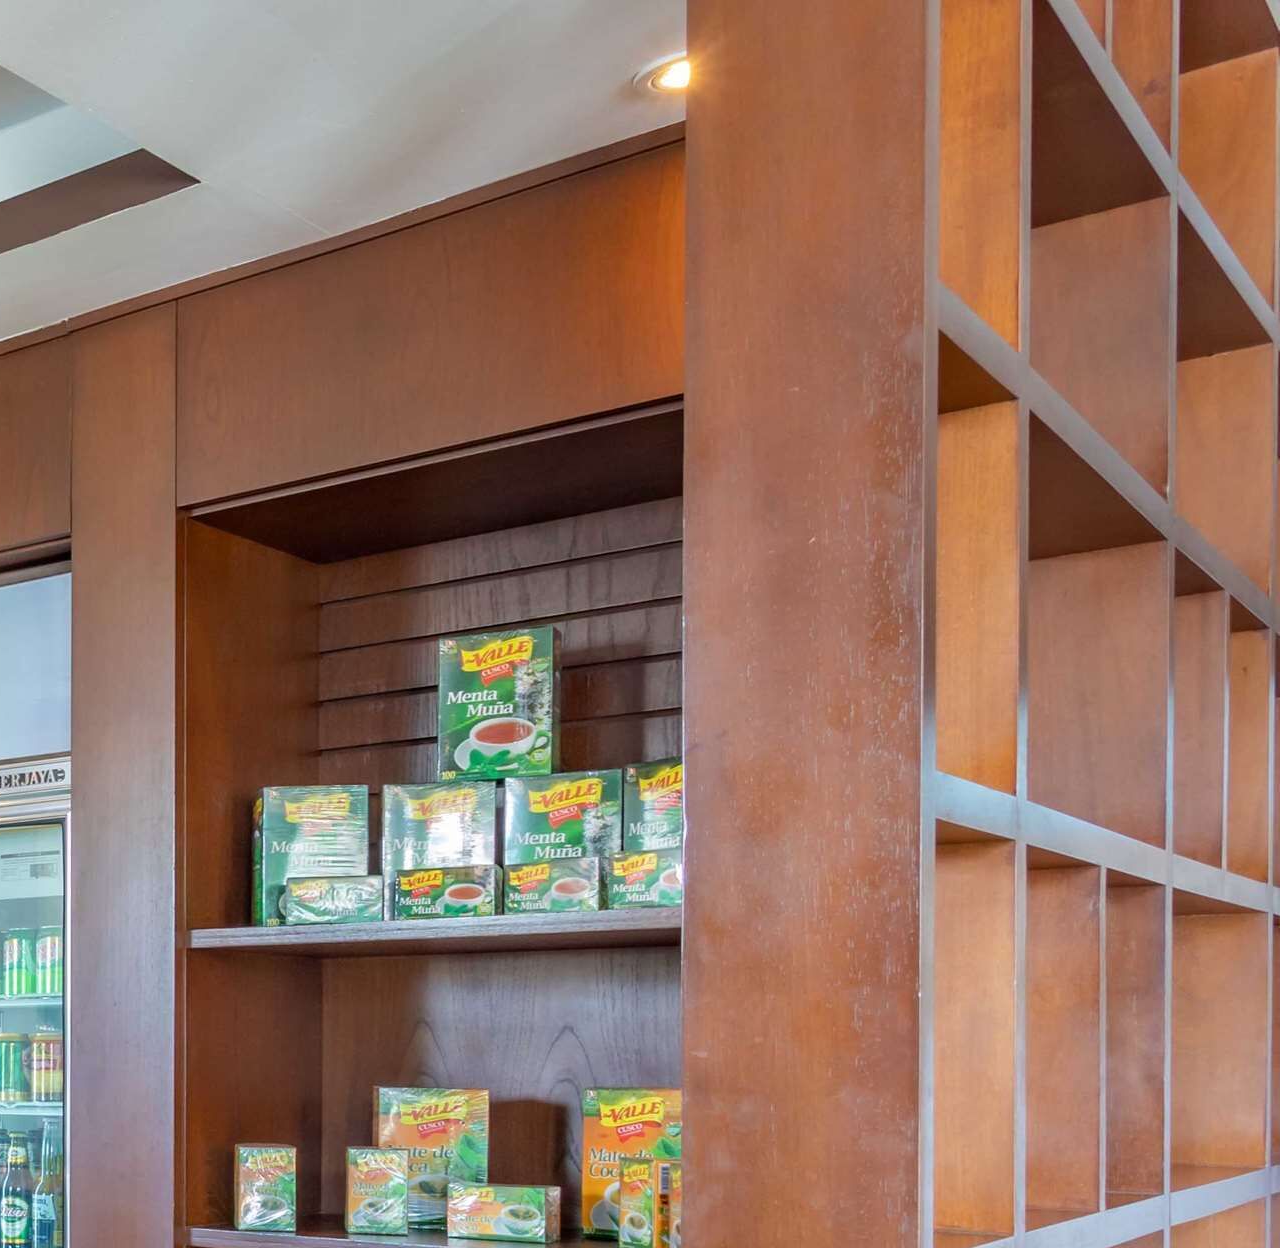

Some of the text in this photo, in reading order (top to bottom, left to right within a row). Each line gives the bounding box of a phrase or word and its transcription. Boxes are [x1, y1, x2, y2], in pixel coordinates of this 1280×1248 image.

[446, 690, 498, 705] Menta
[466, 701, 514, 717] Muña
[647, 771, 682, 792] VALL
[513, 831, 566, 846] Menta
[533, 844, 582, 860] Muña
[608, 1101, 661, 1123] VALLE
[590, 1163, 620, 1178] Coc
